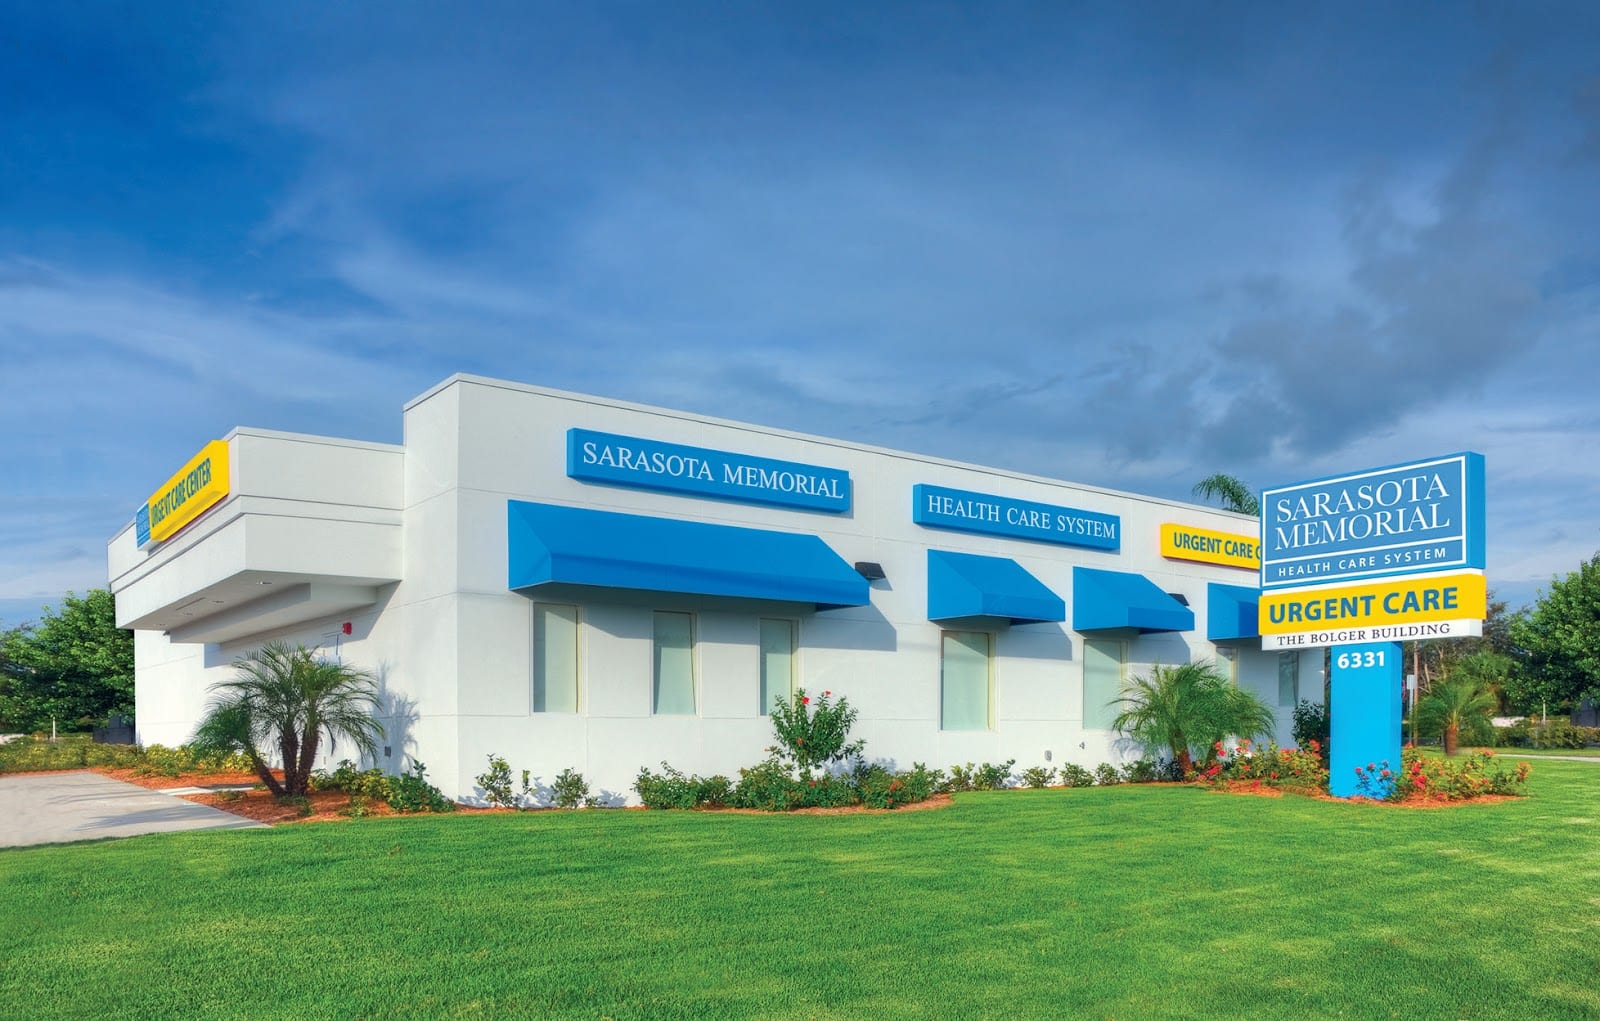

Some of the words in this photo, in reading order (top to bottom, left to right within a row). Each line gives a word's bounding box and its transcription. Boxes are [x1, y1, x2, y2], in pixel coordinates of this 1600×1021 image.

[186, 457, 212, 498] CENTER
[583, 441, 714, 481] SARASOTA
[722, 463, 844, 499] MEMORIAL
[927, 494, 1000, 522] HEALTH
[1006, 507, 1051, 530] CARE
[1057, 515, 1115, 540] SYSTEM
[1276, 472, 1449, 523] SARASOTA
[1173, 531, 1222, 554] URGENT
[1224, 540, 1253, 559] CARE
[1275, 503, 1450, 551] MEMORIAL
[1278, 562, 1331, 577] HEALTH
[1338, 556, 1376, 570] CARE
[1384, 547, 1446, 565] SYSTEM
[1269, 594, 1376, 624] URGENT
[1383, 587, 1458, 615] CARE
[1277, 634, 1305, 646] THE
[1310, 630, 1366, 644] BOLGER
[1372, 623, 1451, 639] BUILDING
[1337, 651, 1385, 669] 6331
